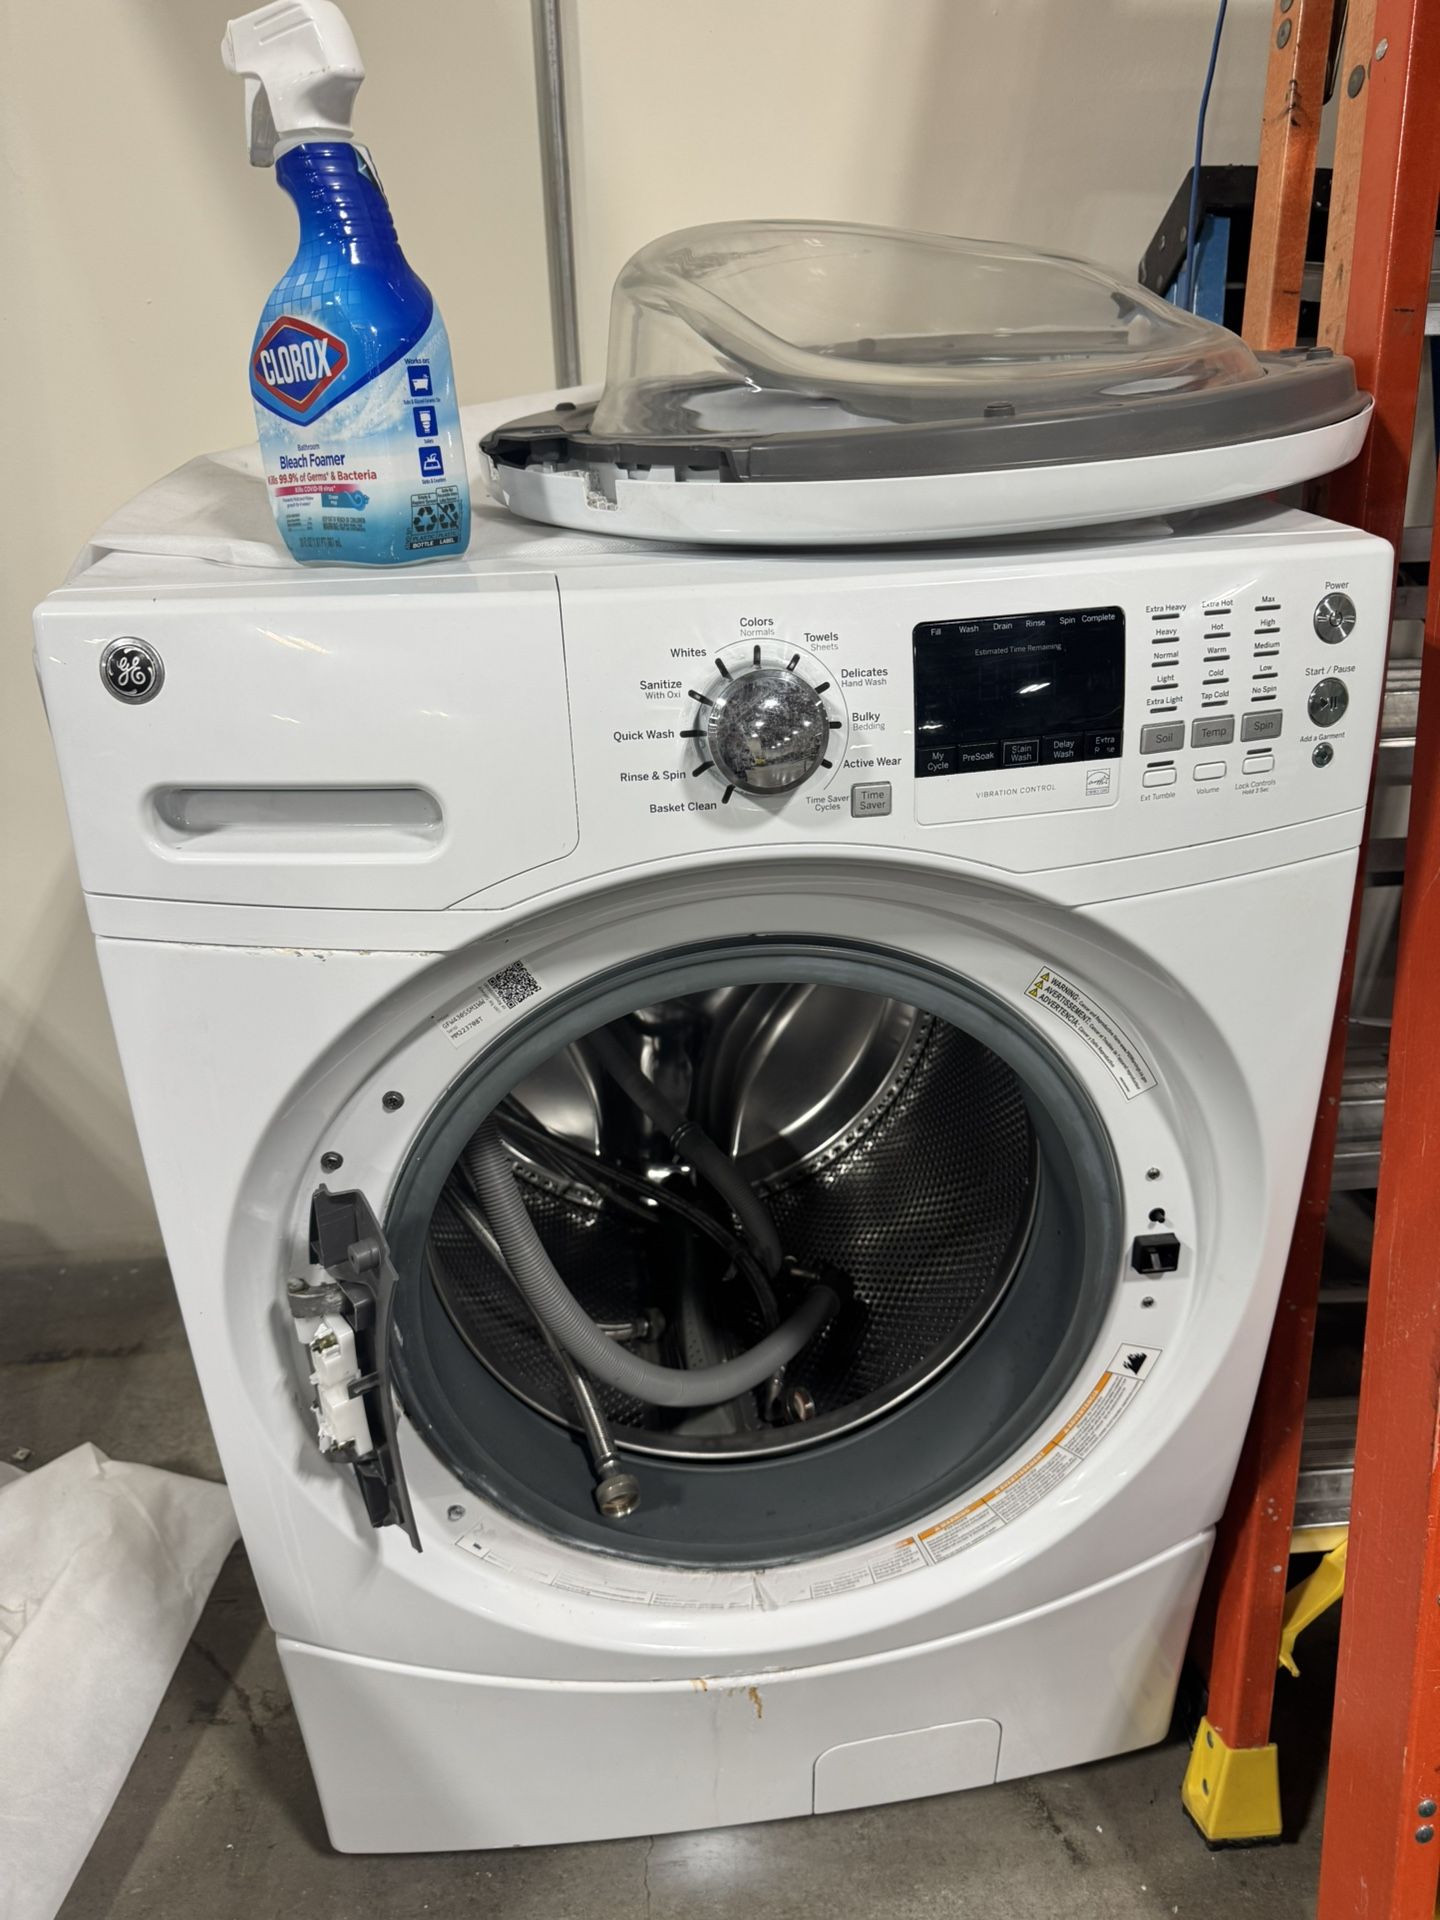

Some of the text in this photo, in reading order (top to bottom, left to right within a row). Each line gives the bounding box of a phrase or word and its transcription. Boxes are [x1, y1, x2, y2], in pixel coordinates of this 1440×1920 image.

[260, 338, 332, 387] CLOROX
[280, 453, 345, 469] Bleach Foamer
[268, 476, 279, 485] Kills
[279, 473, 299, 484] 99.9%
[300, 472, 307, 481] of
[331, 472, 336, 481] &
[337, 469, 377, 481] Bacteria
[412, 541, 434, 549] BOTTLE
[439, 537, 455, 545] LABEL
[1325, 581, 1349, 590] Power
[1145, 603, 1186, 613] Extra Heavy
[1221, 599, 1233, 607] Hot
[739, 617, 774, 627] Colors
[1059, 616, 1076, 625] Spin
[1081, 613, 1115, 623] Complete
[1260, 618, 1275, 627] High
[993, 622, 1013, 630] Drain
[1025, 619, 1045, 628] Rinse
[740, 627, 775, 637] Normals
[930, 628, 941, 636] Fill
[959, 625, 979, 633] Wash
[1156, 627, 1177, 636] Heavy
[804, 632, 839, 642] Towels
[810, 643, 839, 652] Sheets
[975, 643, 1062, 656] Estimated Time Remaining
[1207, 646, 1227, 654] Warm
[1254, 641, 1280, 649] Medium
[670, 647, 707, 658] Whites
[1153, 650, 1179, 659] Normal
[840, 667, 889, 678] Delicates
[1208, 669, 1224, 677] Cold
[1305, 667, 1325, 676] Start
[1333, 664, 1356, 673] Pause
[841, 677, 887, 687] Hand Wash
[1157, 674, 1175, 683] Light
[640, 679, 682, 690] Sanitize
[1263, 684, 1277, 694] Spin
[645, 690, 681, 700] With Oxi
[1201, 690, 1230, 701] Tap Cold
[1146, 695, 1183, 706] Extra Light
[852, 711, 881, 723] Bulky
[852, 721, 886, 732] Bedding
[1254, 721, 1274, 731] Spin
[613, 729, 675, 743] Quick Wash
[1201, 727, 1227, 738] Temp
[1300, 735, 1312, 743] Add
[1318, 731, 1345, 741] Garment
[1095, 736, 1115, 745] Extra
[1155, 733, 1173, 743] Soil
[1011, 744, 1032, 753] Stain
[1053, 740, 1075, 750] Delay
[932, 752, 944, 762] My
[962, 751, 994, 761] PreSoak
[1010, 752, 1032, 761] Wash
[1053, 749, 1074, 758] Wash
[843, 756, 902, 768] Active Wear
[927, 762, 949, 772] Cycle
[620, 770, 686, 782] Rinse & Spin
[1235, 779, 1276, 791] Lock Controls
[860, 790, 885, 800] Time
[976, 784, 1056, 799] VIBRATION CONTROL
[1196, 786, 1220, 795] Volume
[806, 794, 850, 805] Time Saver
[1140, 791, 1176, 802] Ext Tumble
[649, 801, 717, 814] Basket Clean
[815, 803, 841, 812] Cycles
[860, 800, 886, 810] Saver
[1050, 977, 1080, 1002] WARNING:
[1038, 993, 1080, 1028] ADVERTENCIA:
[1044, 986, 1092, 1025] AVERTISSEMENT:
